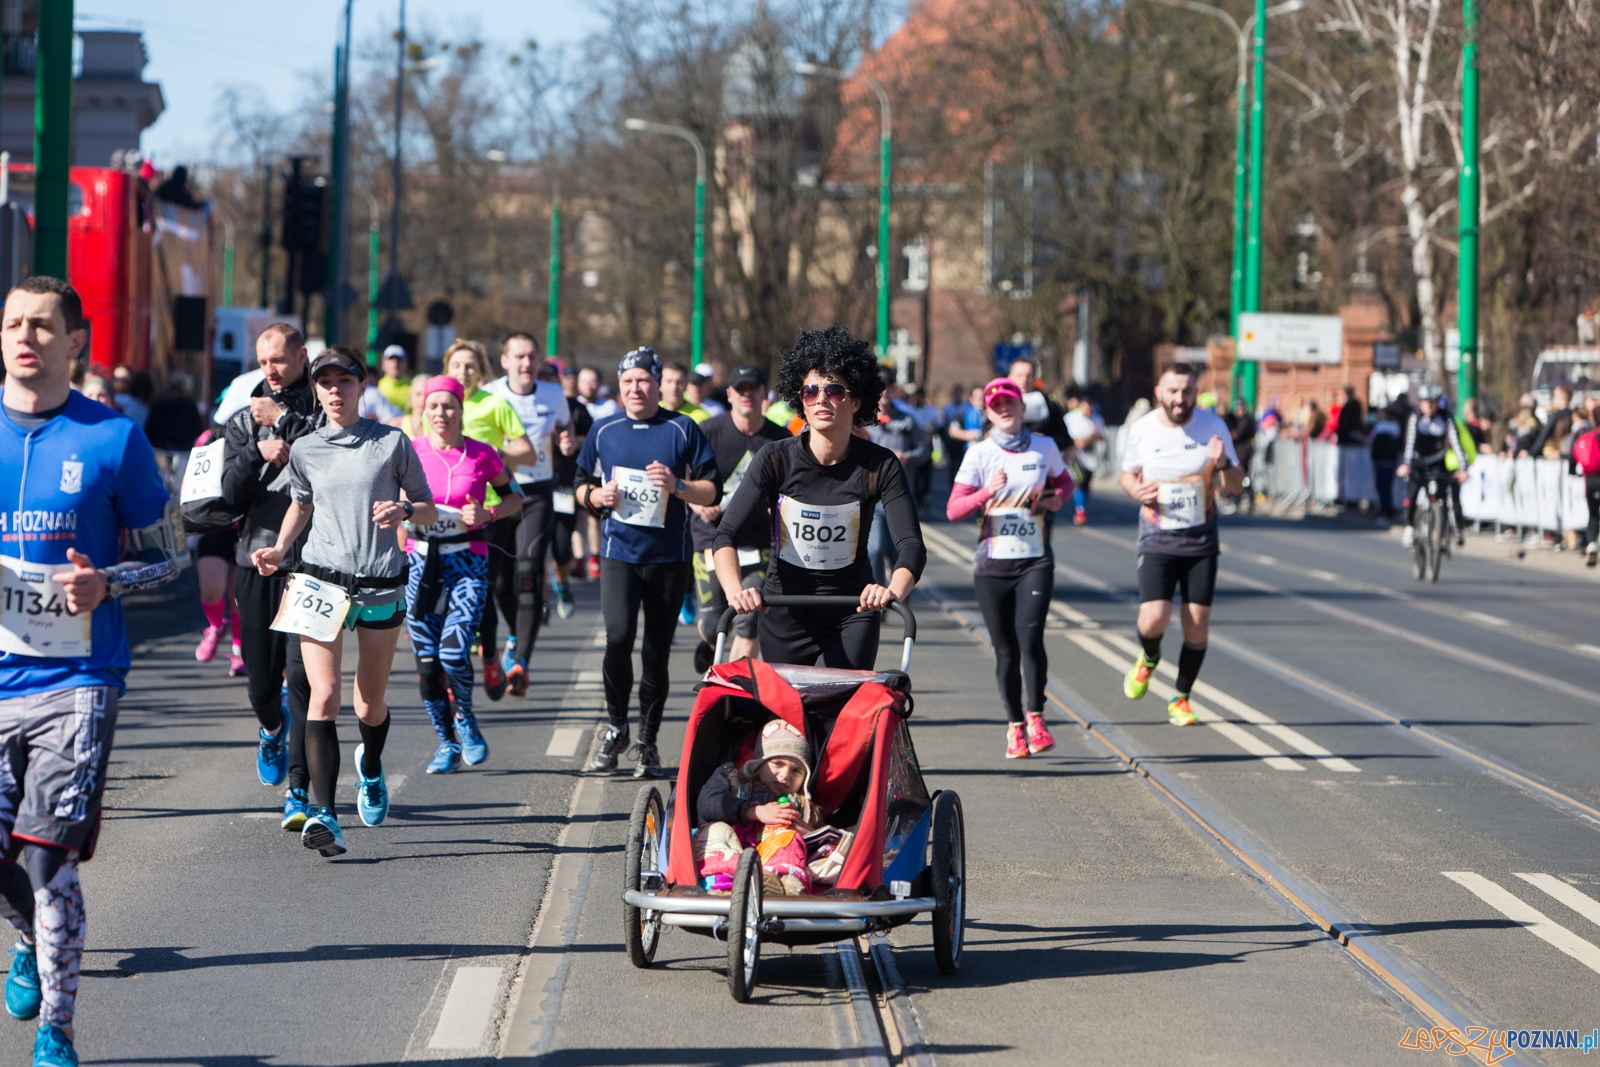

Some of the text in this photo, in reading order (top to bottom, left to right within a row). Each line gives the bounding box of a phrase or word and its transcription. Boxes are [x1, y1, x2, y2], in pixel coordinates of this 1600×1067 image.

[194, 459, 211, 476] 20
[623, 486, 660, 503] 1663
[12, 509, 77, 532] POZNAŃ
[1000, 522, 1036, 536] 6763
[792, 522, 846, 543] 1802
[294, 591, 334, 619] 7612
[28, 619, 54, 628] Patryk
